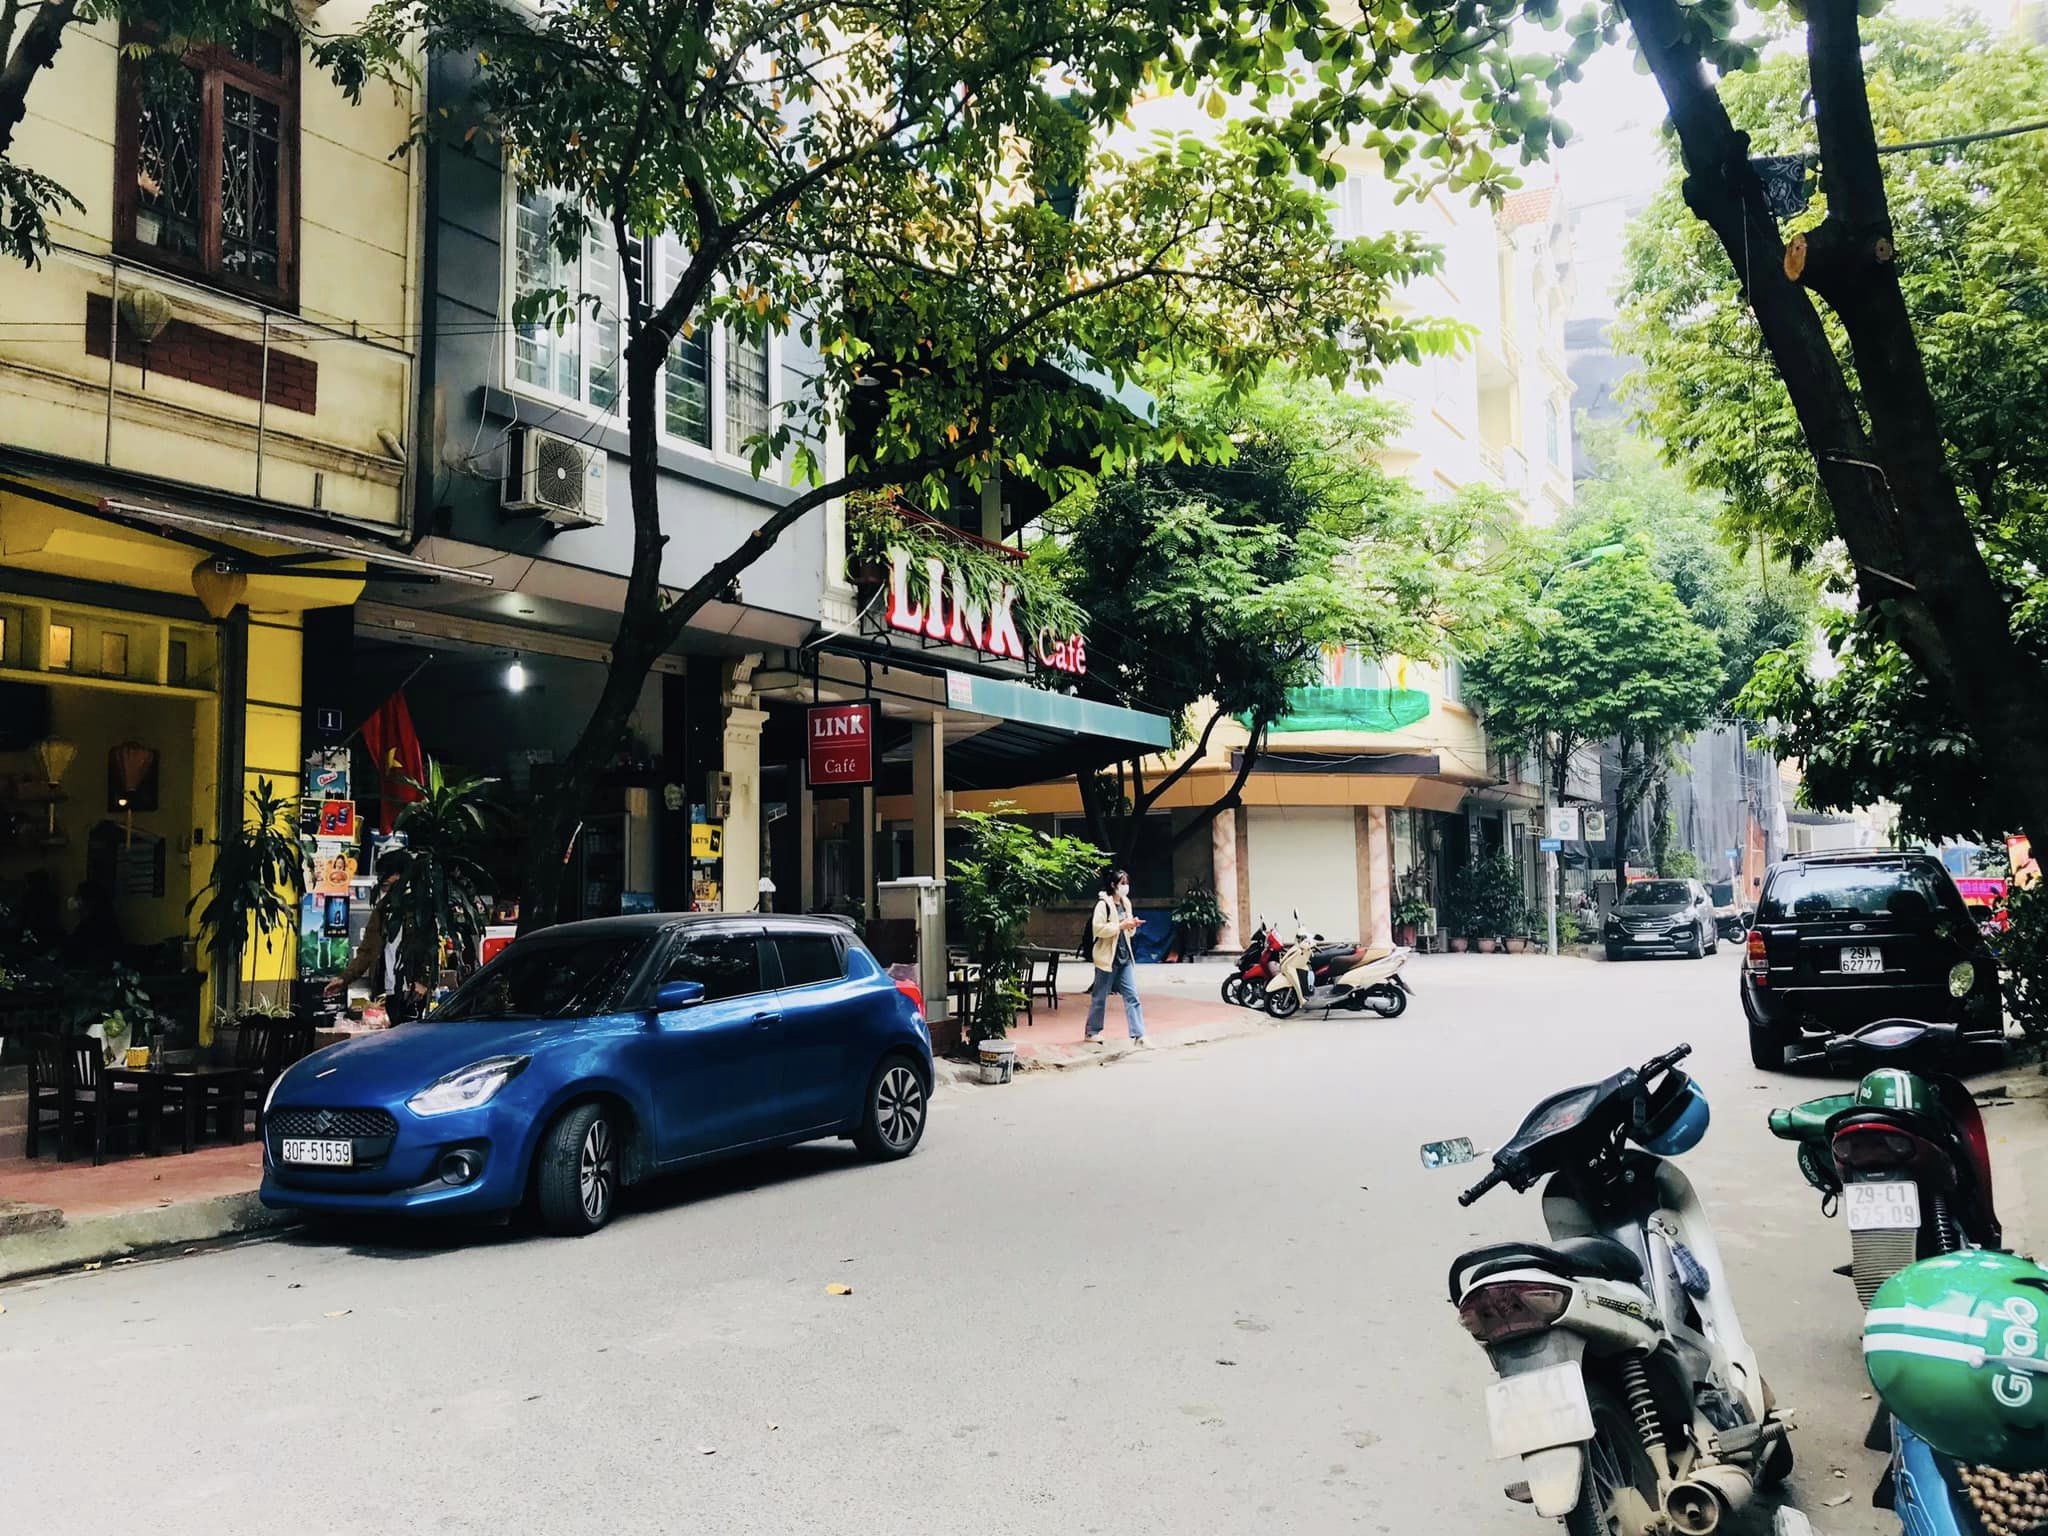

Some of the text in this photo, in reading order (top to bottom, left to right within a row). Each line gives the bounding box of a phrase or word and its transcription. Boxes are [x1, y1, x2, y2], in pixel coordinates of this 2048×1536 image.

[888, 545, 1087, 675] LINK Café
[327, 712, 333, 727] 1
[814, 714, 865, 737] LINK
[824, 758, 856, 774] Café
[1849, 946, 1873, 960] 29A
[284, 1141, 350, 1163] 30F-515.59
[1855, 1185, 1906, 1204] 29-C1
